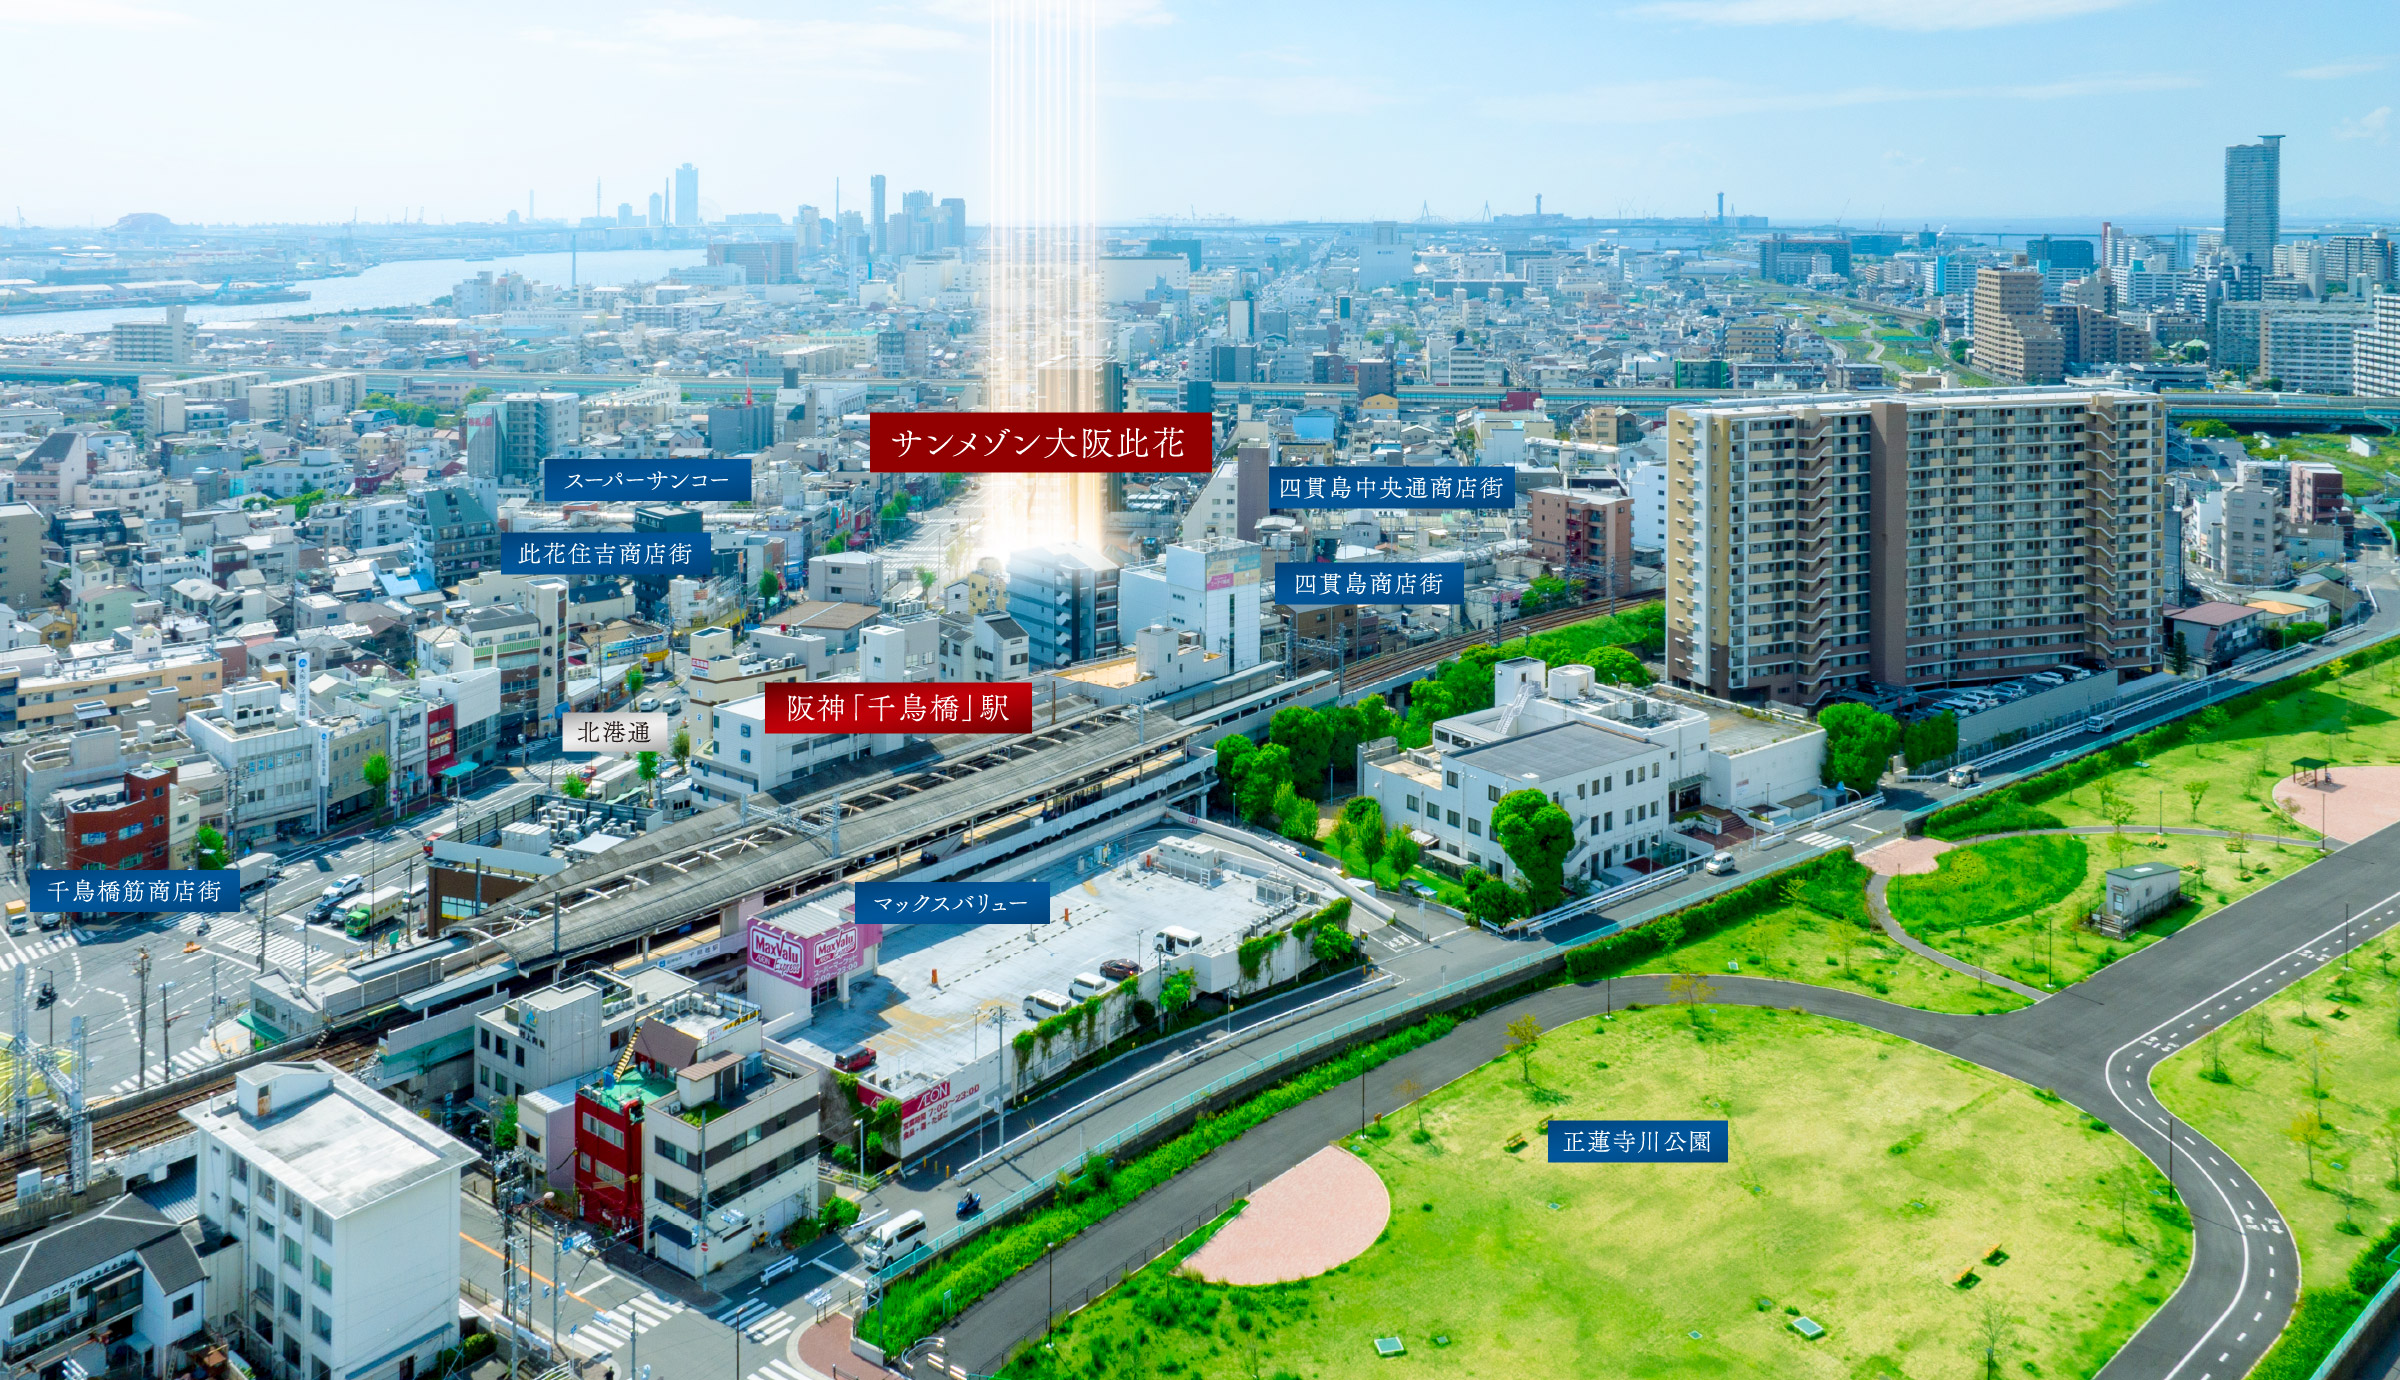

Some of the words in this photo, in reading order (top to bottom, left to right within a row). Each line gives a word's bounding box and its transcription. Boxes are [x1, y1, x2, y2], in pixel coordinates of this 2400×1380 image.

[755, 934, 799, 964] MaxValu
[818, 930, 854, 956] MaxValu
[774, 957, 801, 977] Express
[814, 954, 858, 978] スーパーマーケット
[903, 1112, 927, 1131] 営業時間
